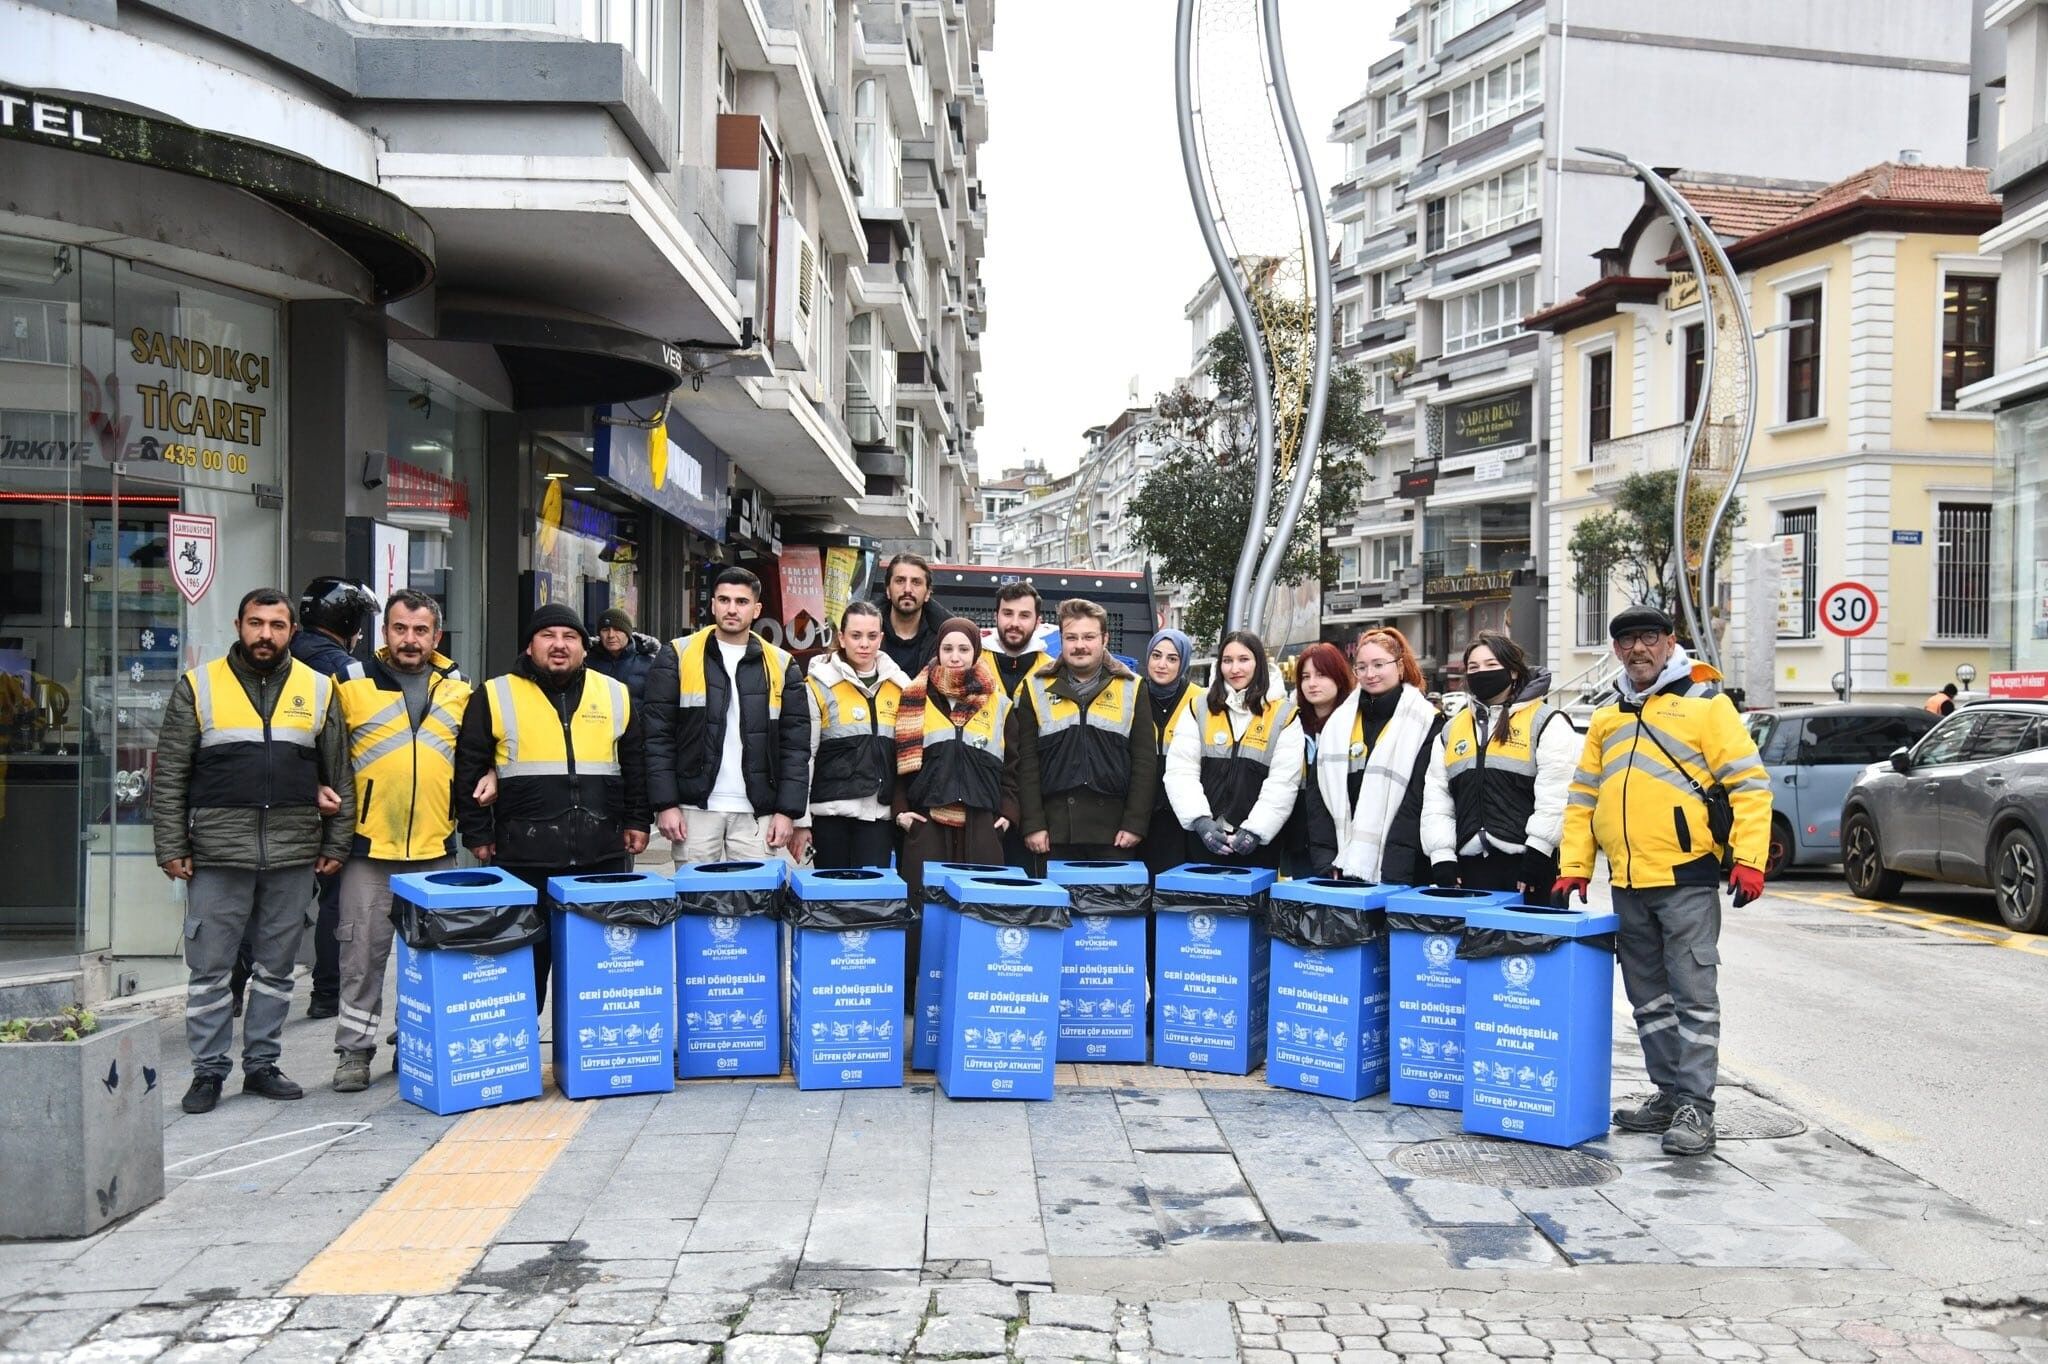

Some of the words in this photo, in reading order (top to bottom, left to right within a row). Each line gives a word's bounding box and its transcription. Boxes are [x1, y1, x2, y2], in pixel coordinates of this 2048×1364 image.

[0, 94, 102, 144] TEL
[131, 327, 270, 393] SANDIKÇI
[136, 379, 266, 446] TİCARET
[163, 442, 198, 467] 435
[202, 449, 222, 470] 00
[227, 453, 248, 475] 00
[175, 523, 210, 535] SAMSUNSPOR
[781, 566, 819, 576] SAMSUN
[185, 578, 200, 588] 1965
[1831, 597, 1866, 622] 30
[1075, 939, 1117, 947] BÜYÜKŞEHİR
[702, 947, 747, 957] BÜYÜKŞEHİR
[597, 960, 644, 969] BÜYÜKŞEHİR
[831, 957, 876, 965] BÜYÜKŞEHİR
[463, 967, 507, 981] BÜYÜKŞEHİR
[987, 964, 1033, 973] BÜYÜKŞEHİR
[1080, 964, 1134, 975] DÖNÜŞEBİLİR
[686, 975, 706, 985] GERİ
[708, 973, 765, 986] DÖNÜŞEBİLİR
[1080, 977, 1113, 985] ATIKLAR
[1164, 970, 1182, 980] GERİ
[1184, 972, 1238, 985] DÖNÜŞEBİLİR
[1416, 974, 1461, 985] BÜYÜKŞEHİR
[579, 988, 601, 1000] GERİ
[603, 986, 662, 999] DÖNÜŞEBİLİR
[708, 987, 744, 997] ATIKLAR
[812, 985, 833, 995] GERİ
[835, 983, 893, 996] DÖNÜŞEBİLİR
[1184, 985, 1217, 994] ATIKLAR
[1278, 986, 1296, 997] GERİ
[1297, 989, 1349, 1005] DÖNÜŞEBİLİR
[447, 1000, 468, 1014] GERİ
[469, 992, 526, 1010] DÖNÜŞEBİLİR
[835, 998, 871, 1006] ATIKLAR
[968, 991, 989, 1000] GERİ
[991, 991, 1049, 1004] DÖNÜŞEBİLİR
[1493, 994, 1540, 1006] BÜYÜKŞEHİR
[603, 1001, 640, 1011] ATIKLAR
[989, 1005, 1026, 1015] ATIKLAR
[1296, 1002, 1328, 1014] ATIKLAR
[1400, 1000, 1419, 1010] GERİ
[470, 1009, 505, 1023] ATIKLAR
[1421, 1015, 1456, 1027] ATIKLAR
[1062, 1027, 1086, 1035] LÜTFEN
[1088, 1028, 1100, 1037] ÇÖP
[1101, 1027, 1131, 1036] ATMAYIN!
[1475, 1021, 1495, 1033] GERİ
[1497, 1023, 1558, 1040] DÖNÜŞEBİLİR
[690, 1040, 716, 1050] LÜTFEN
[718, 1040, 731, 1051] ÇÖP
[732, 1039, 763, 1049] ATMAYIN!
[1166, 1032, 1189, 1042] LÜTFEN
[1190, 1034, 1203, 1045] ÇÖP
[1203, 1037, 1233, 1047] ATMAYIN!
[1496, 1039, 1535, 1051] ATIKLAR
[583, 1057, 610, 1068] LÜTFEN
[612, 1056, 625, 1068] ÇÖP
[627, 1055, 659, 1065] ATMAYIN!
[814, 1051, 841, 1061] LÜTFEN
[843, 1051, 857, 1061] ÇÖP
[857, 1050, 888, 1059] ATMAYIN!
[1278, 1051, 1300, 1063] LÜTFEN
[1302, 1054, 1313, 1065] ÇÖP
[1314, 1057, 1343, 1070] ATMAYIN!
[966, 1059, 993, 1069] LÜTFEN
[994, 1060, 1007, 1071] ÇÖP
[1009, 1062, 1041, 1070] ATMAYIN!
[454, 1070, 480, 1083] LÜTFEN
[481, 1068, 495, 1081] ÇÖP
[496, 1062, 527, 1076] ATMAYIN!
[1403, 1068, 1427, 1078] LÜTFEN
[1429, 1069, 1443, 1082] ÇÖP
[1476, 1094, 1502, 1106] LÜTFEN
[1503, 1096, 1517, 1109] ÇÖP
[1519, 1100, 1552, 1113] ATMAYIN!
